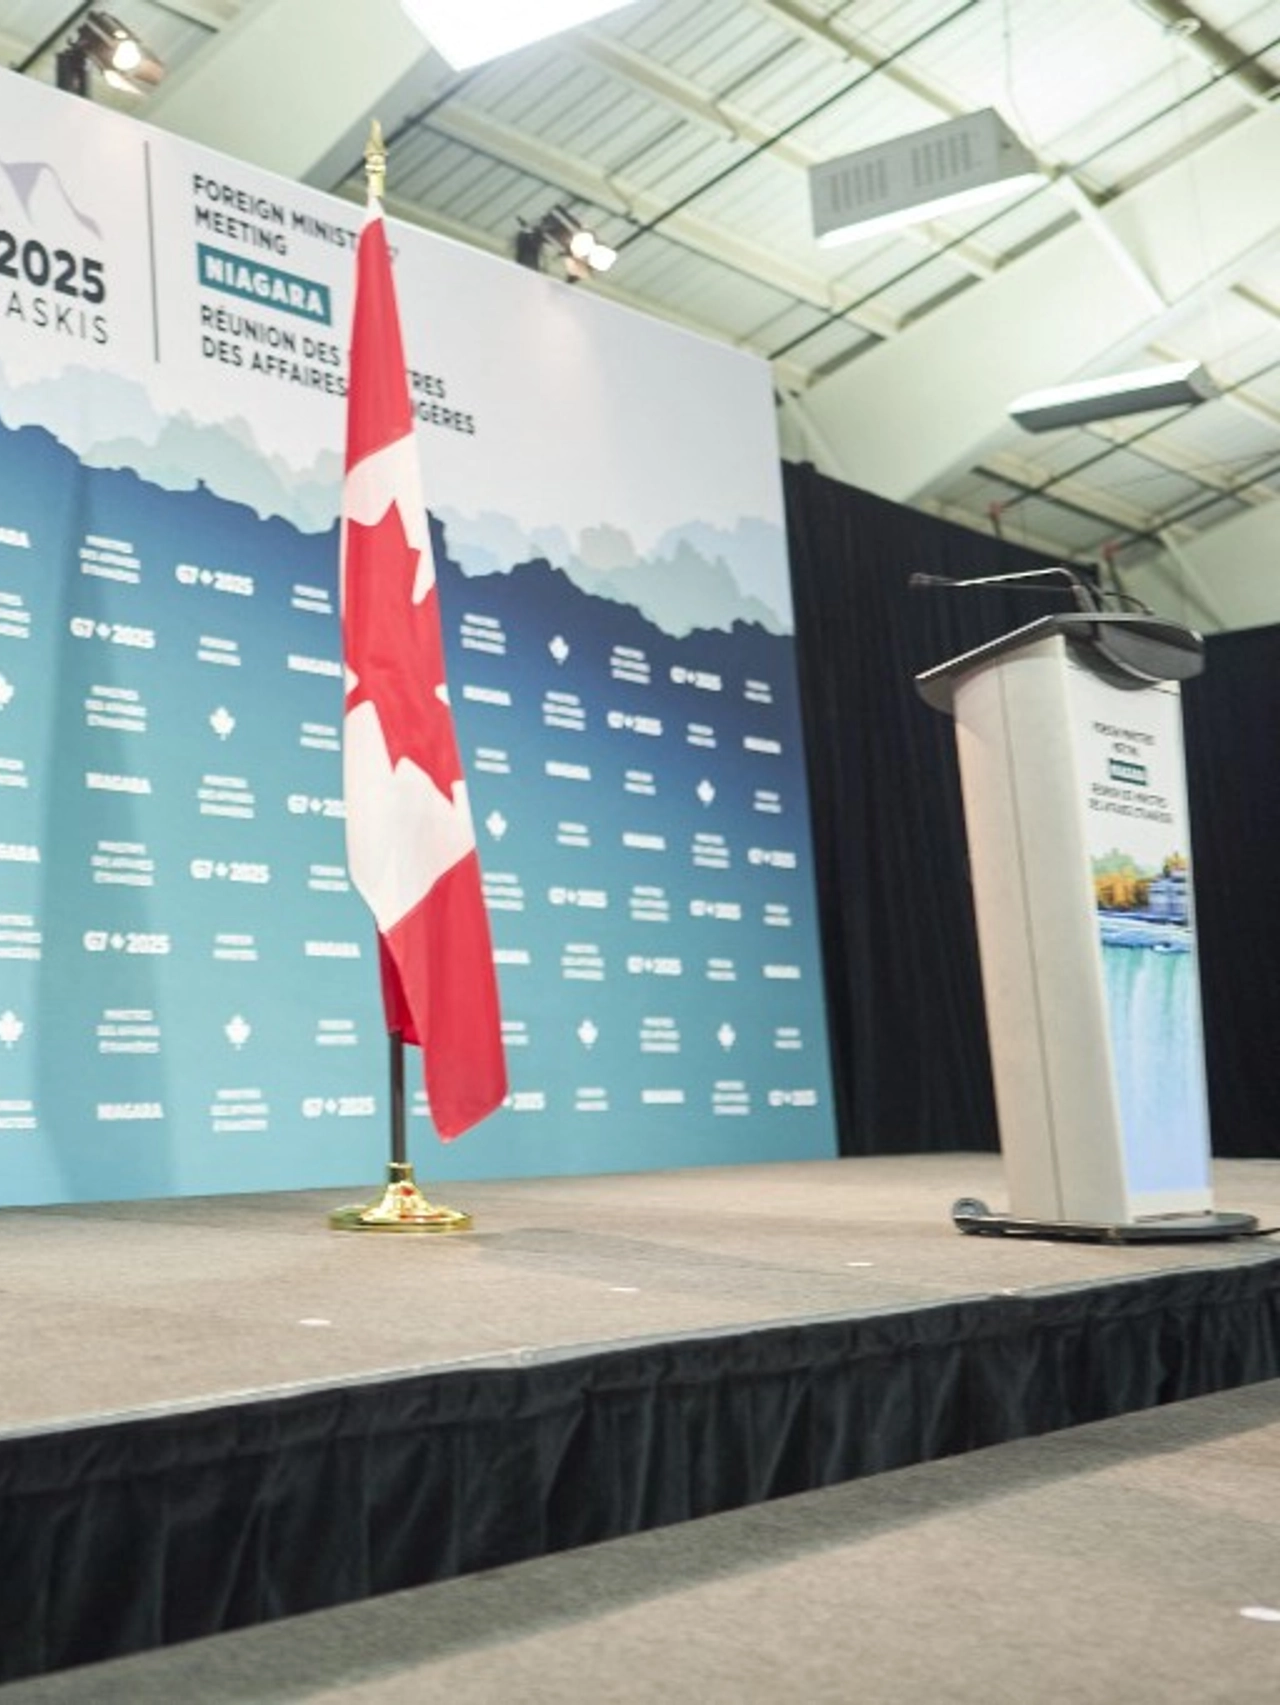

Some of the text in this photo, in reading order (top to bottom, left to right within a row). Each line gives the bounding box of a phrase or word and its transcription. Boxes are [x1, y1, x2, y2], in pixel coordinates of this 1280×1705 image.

[192, 174, 284, 224] FOREIGN
[194, 204, 288, 256] MEETING
[203, 256, 325, 317] NIAGARA
[200, 303, 341, 367] RÉUNION DES
[201, 334, 349, 397] DES AFFAIRES
